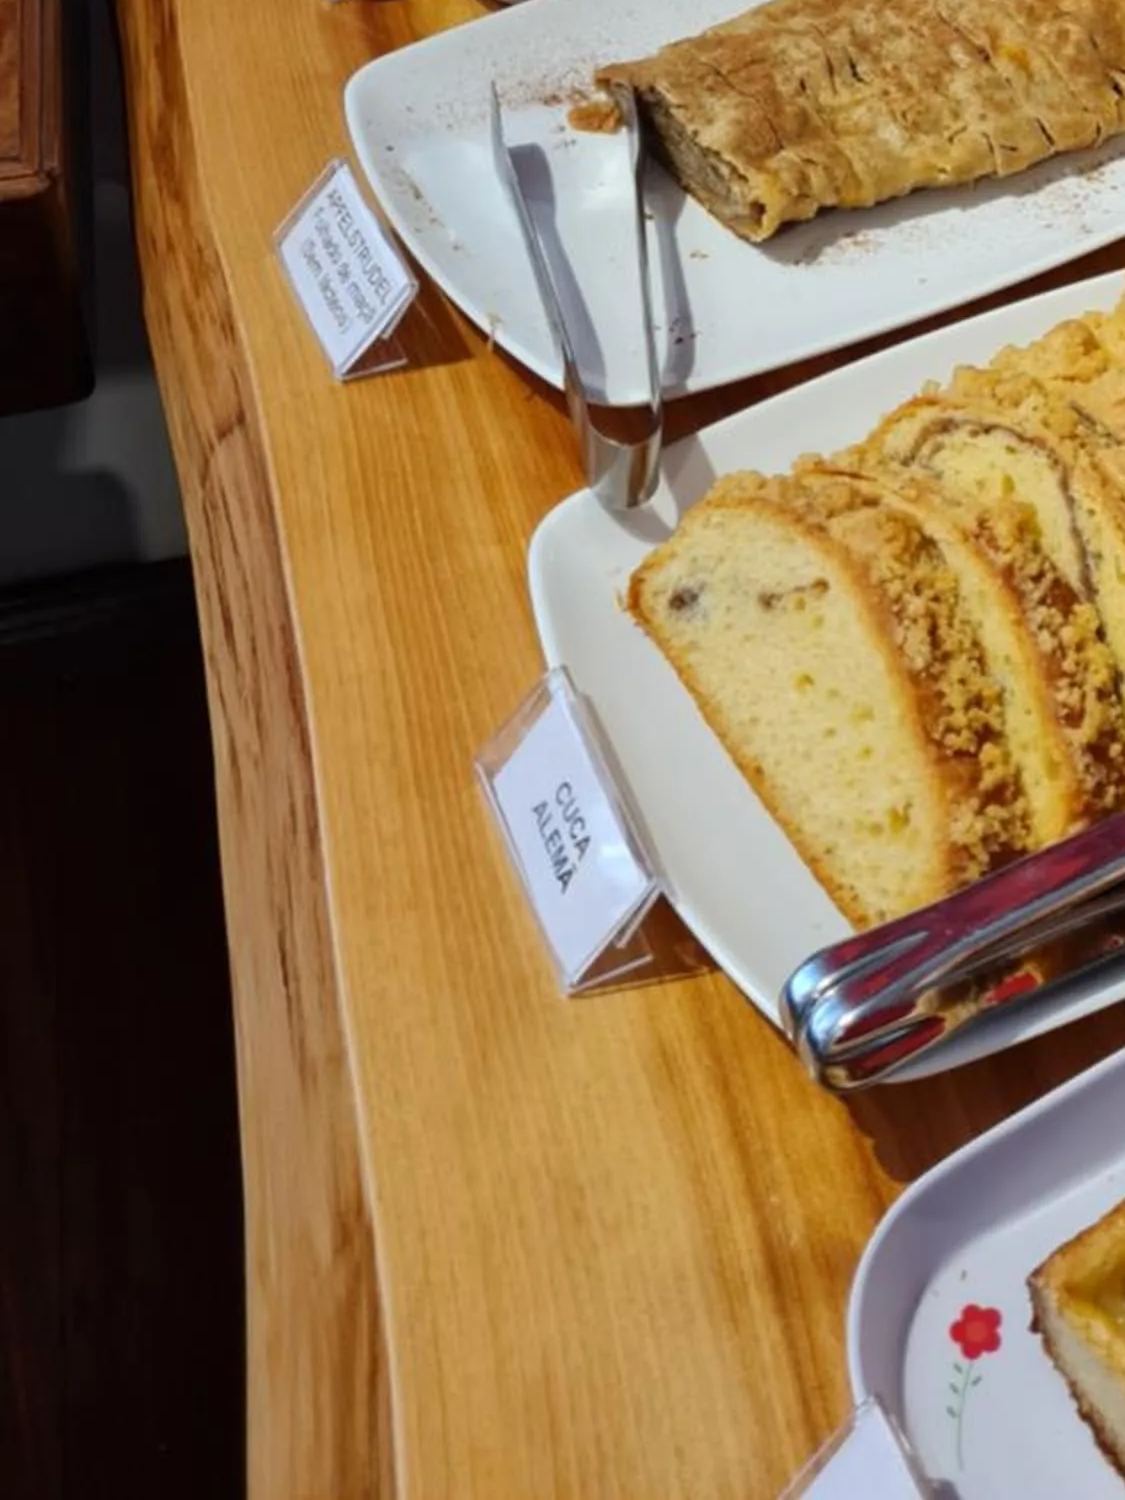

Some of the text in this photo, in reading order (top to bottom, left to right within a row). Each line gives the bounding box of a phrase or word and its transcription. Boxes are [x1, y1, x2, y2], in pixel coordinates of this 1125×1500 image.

[327, 189, 395, 305] APFELSTRUDEL
[532, 800, 579, 896] ALEMÃ
[554, 781, 592, 861] CUCA
